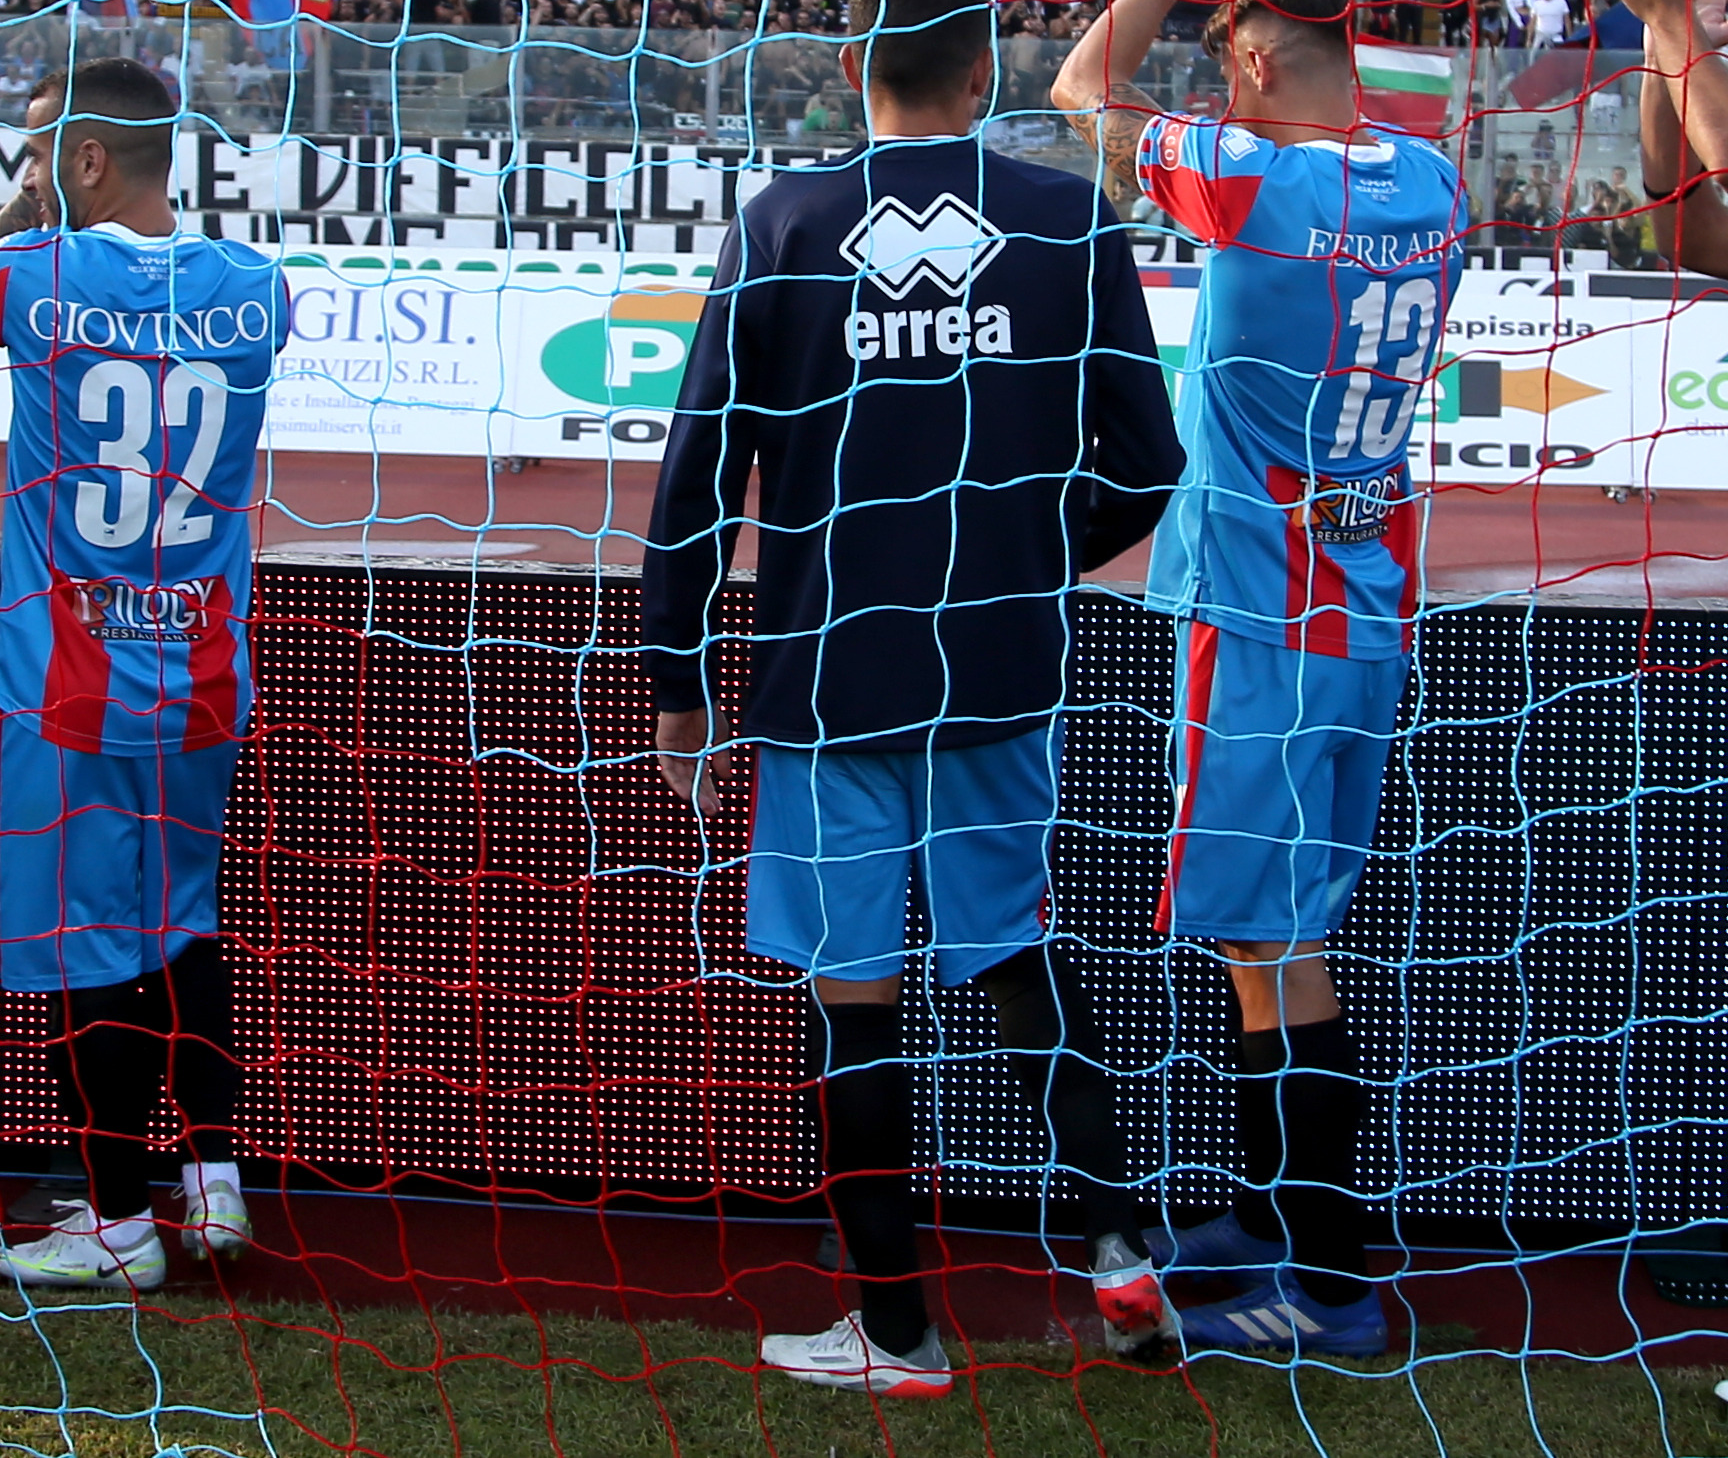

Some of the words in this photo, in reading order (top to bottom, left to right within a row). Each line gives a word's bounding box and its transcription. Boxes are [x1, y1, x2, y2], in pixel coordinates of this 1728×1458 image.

[27, 297, 269, 352] GIOVINCO
[1443, 316, 1595, 340] apisarda
[276, 357, 383, 384] ERVIZI
[1328, 277, 1437, 460] 13
[562, 416, 669, 443] FO
[74, 359, 229, 549] 32
